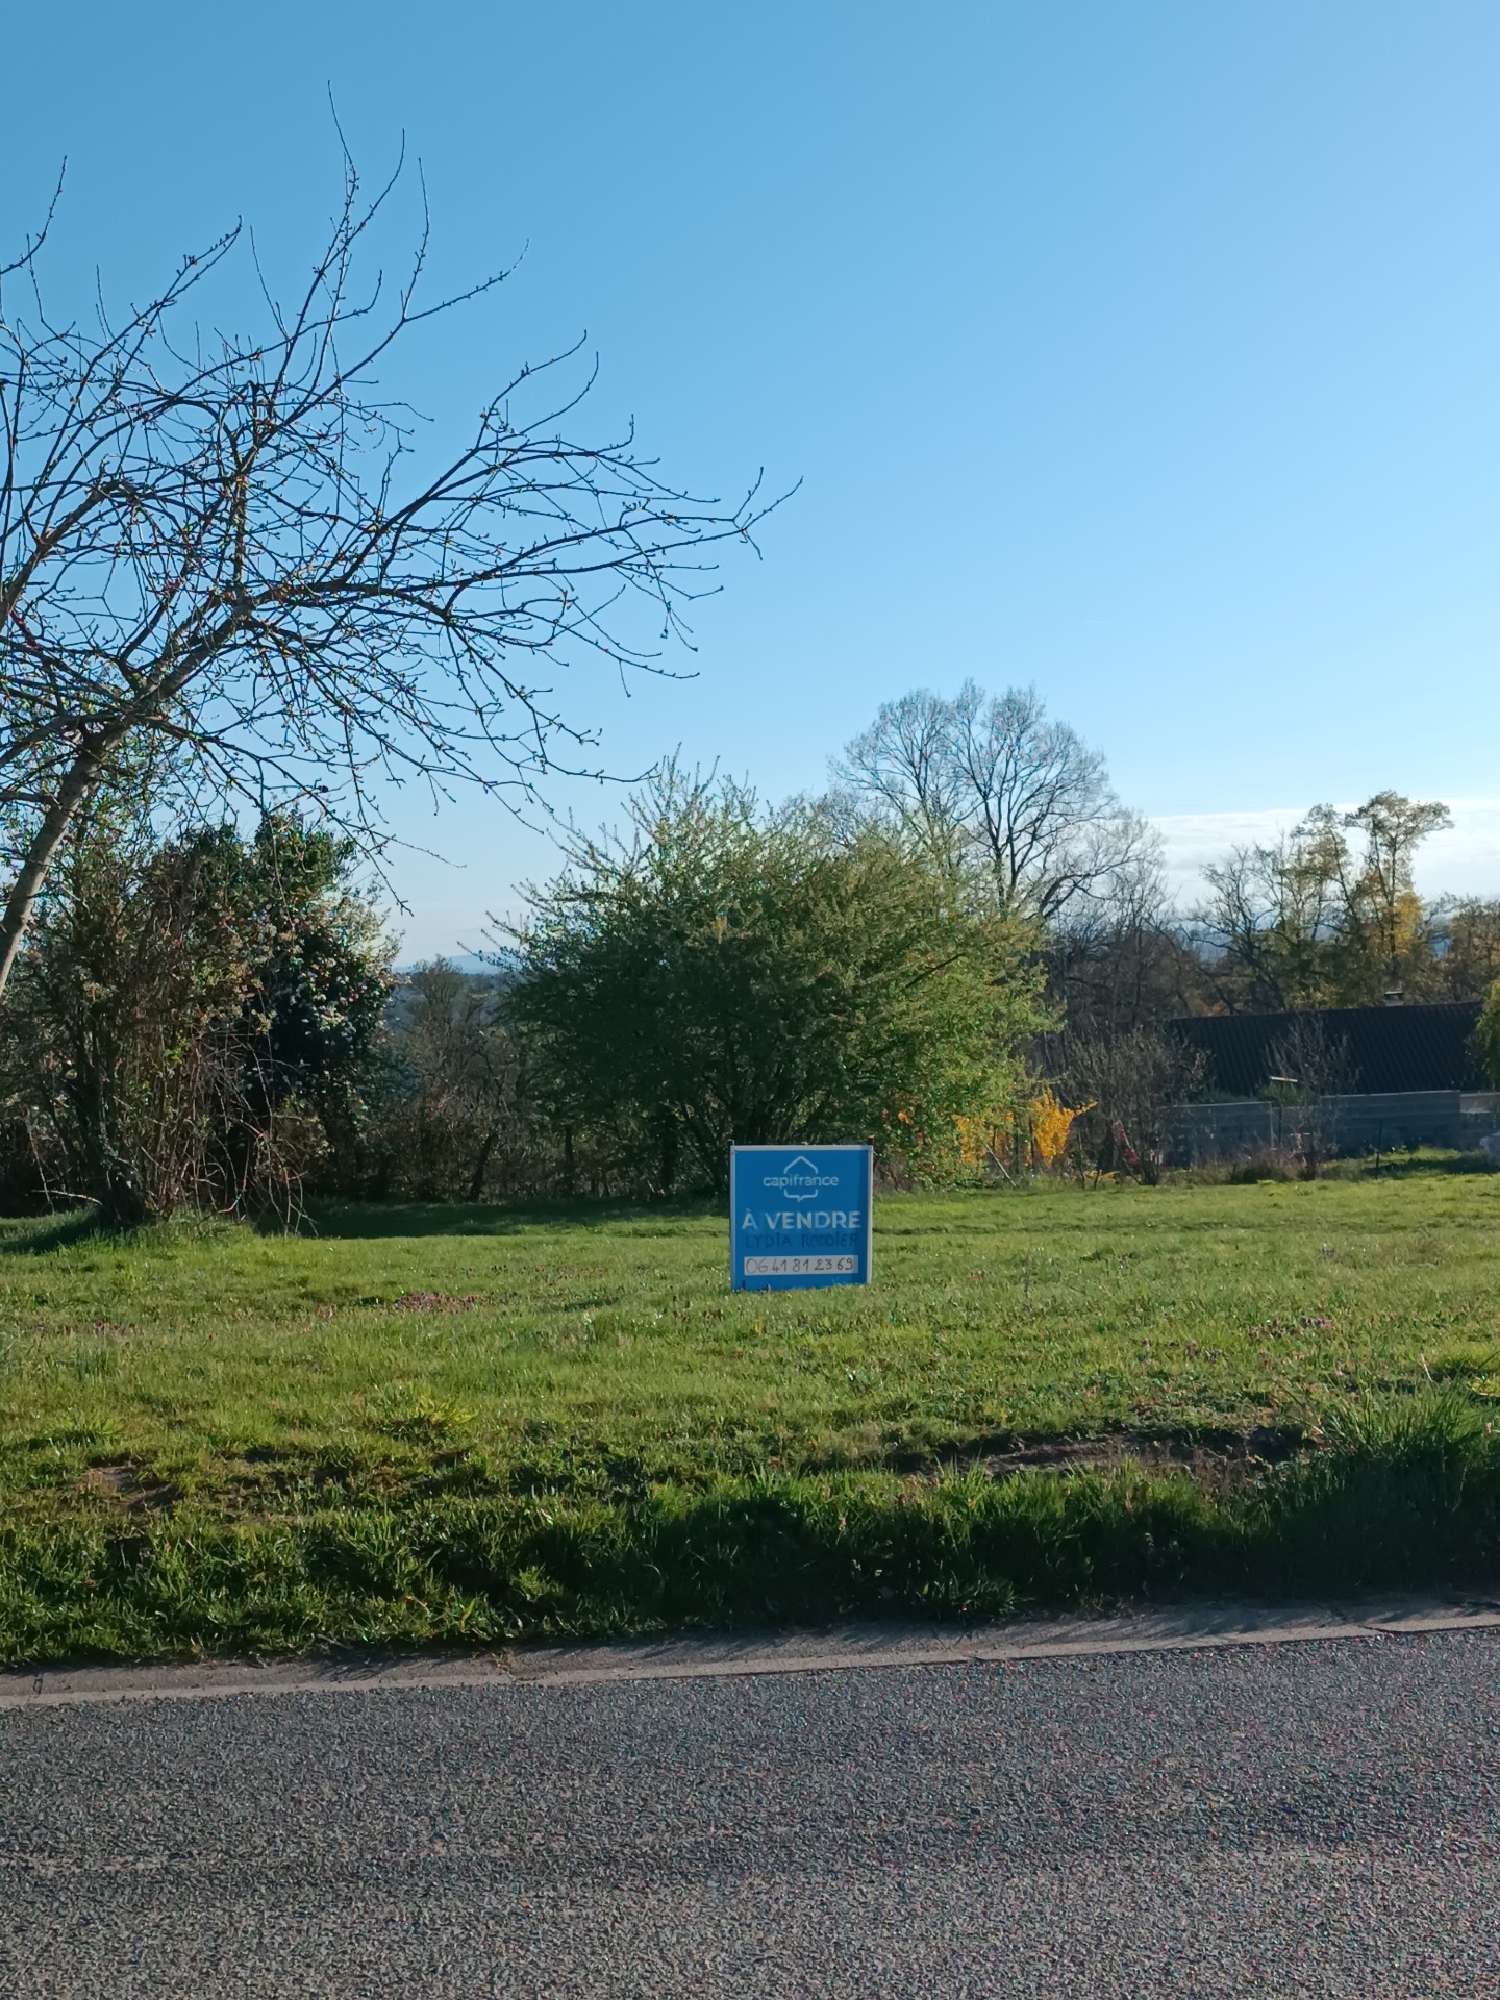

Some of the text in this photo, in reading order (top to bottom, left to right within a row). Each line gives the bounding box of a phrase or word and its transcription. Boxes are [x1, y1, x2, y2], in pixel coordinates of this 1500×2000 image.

[763, 1173, 840, 1190] capifrance
[765, 1210, 861, 1230] VENDRE
[746, 1257, 769, 1273] 06
[772, 1258, 788, 1272] 41
[792, 1258, 809, 1272] 81
[814, 1258, 833, 1271] 23
